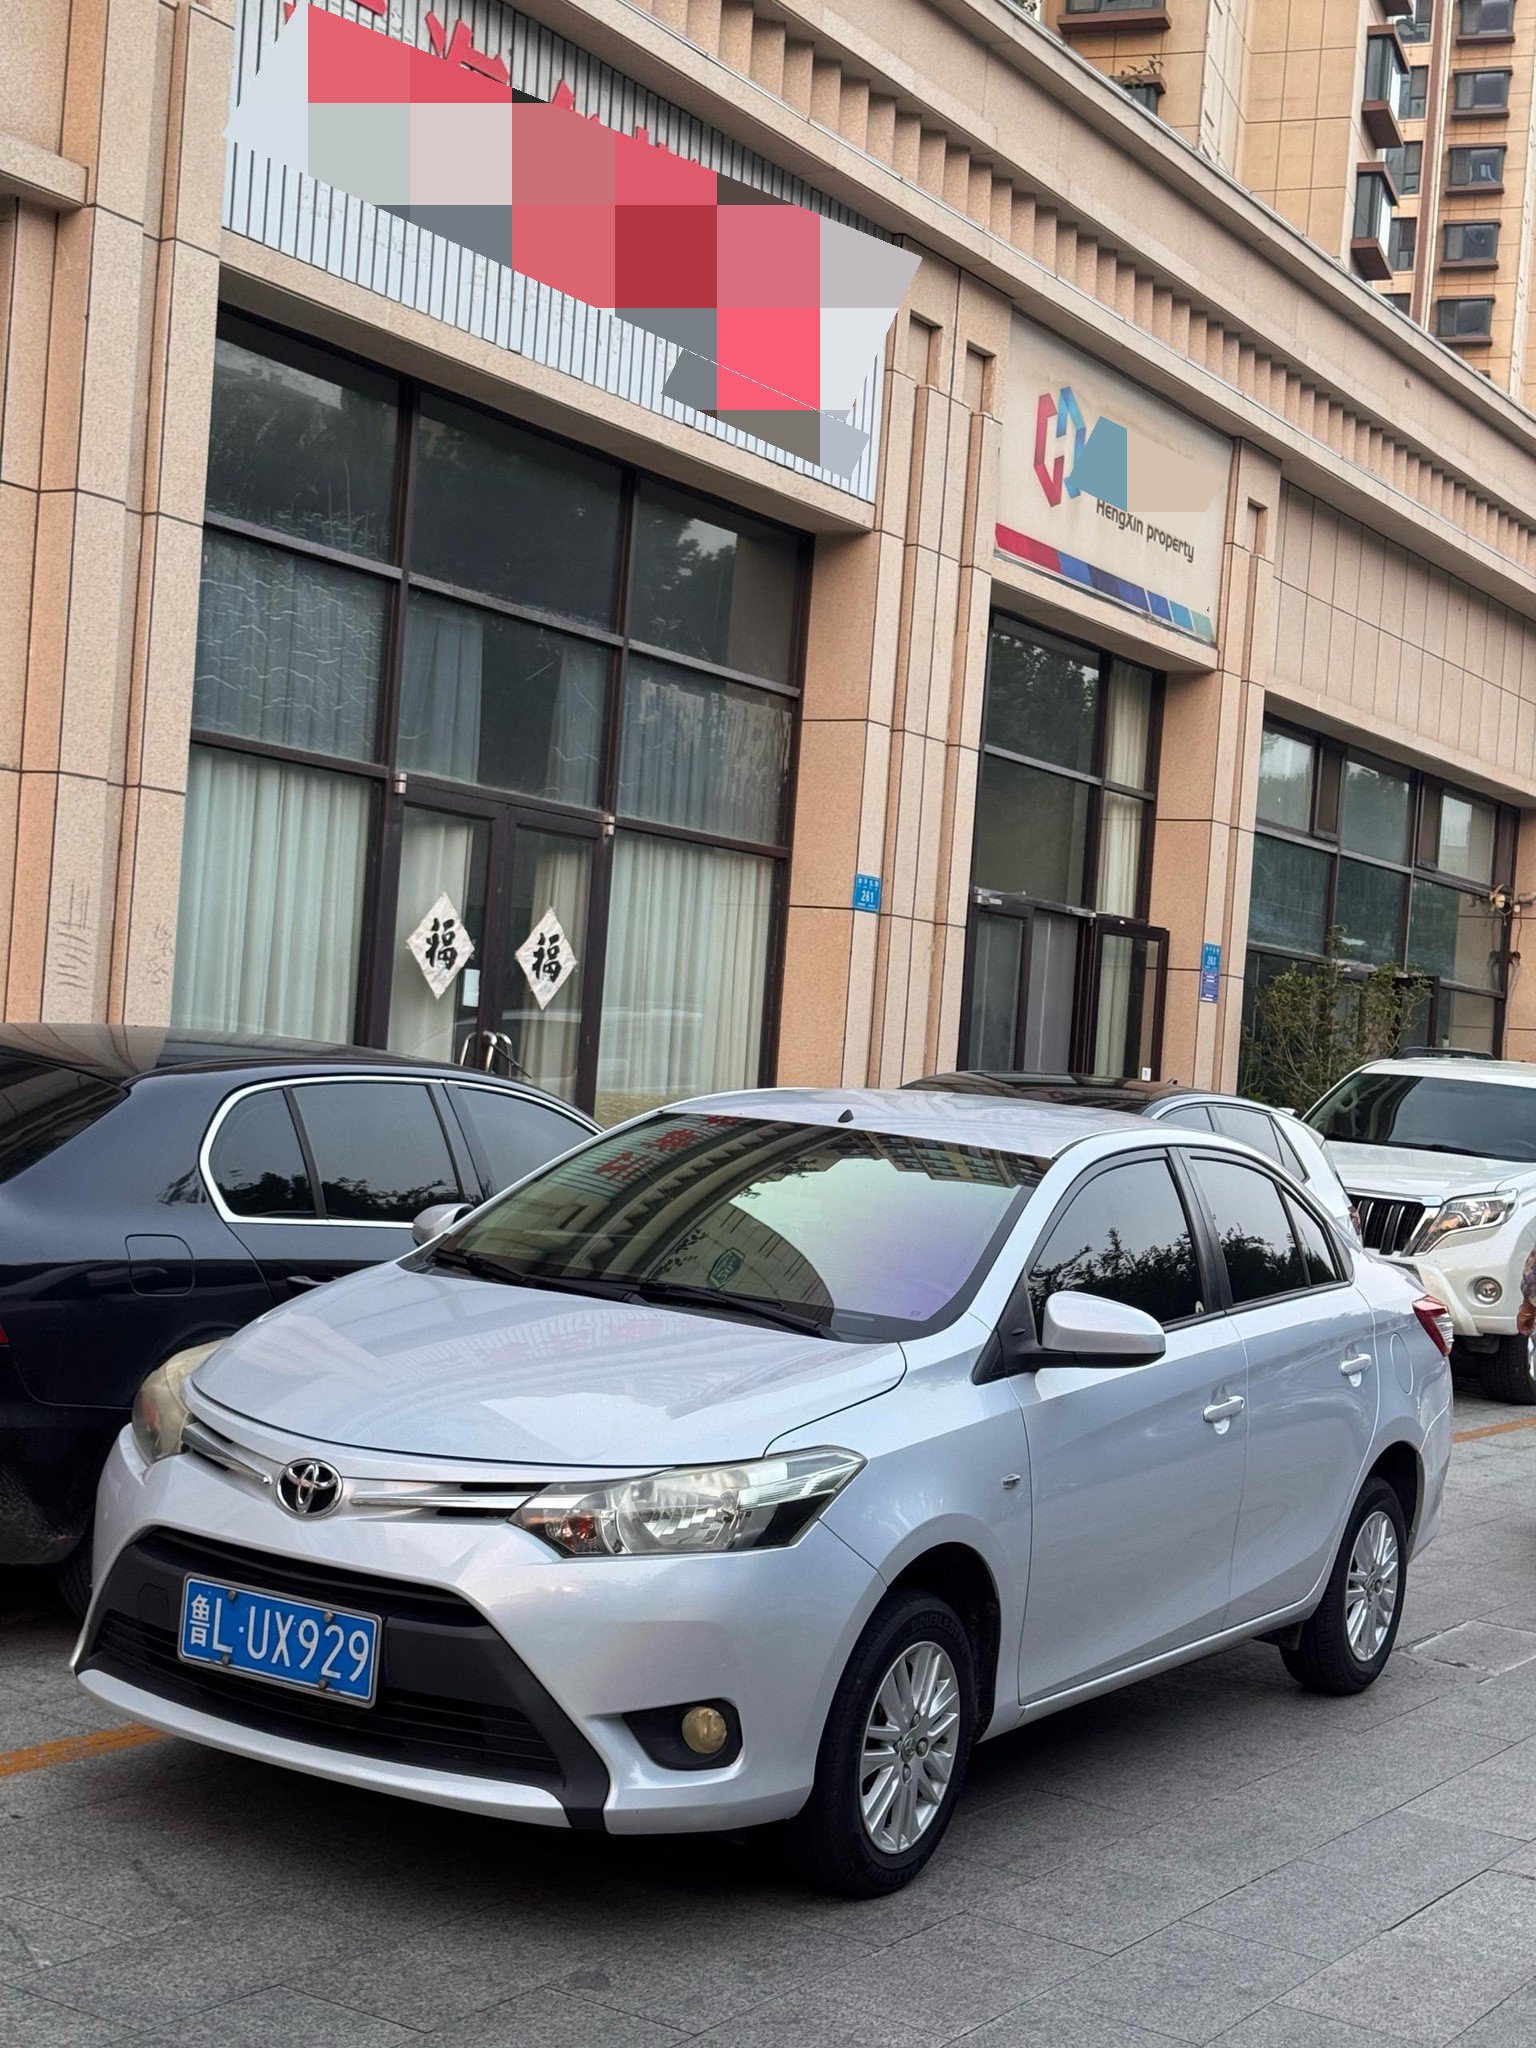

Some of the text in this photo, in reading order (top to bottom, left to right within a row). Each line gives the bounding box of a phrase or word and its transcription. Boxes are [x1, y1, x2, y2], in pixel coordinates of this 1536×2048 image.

[1146, 524, 1195, 563] property
[425, 918, 458, 970] 福
[532, 933, 562, 983] 福
